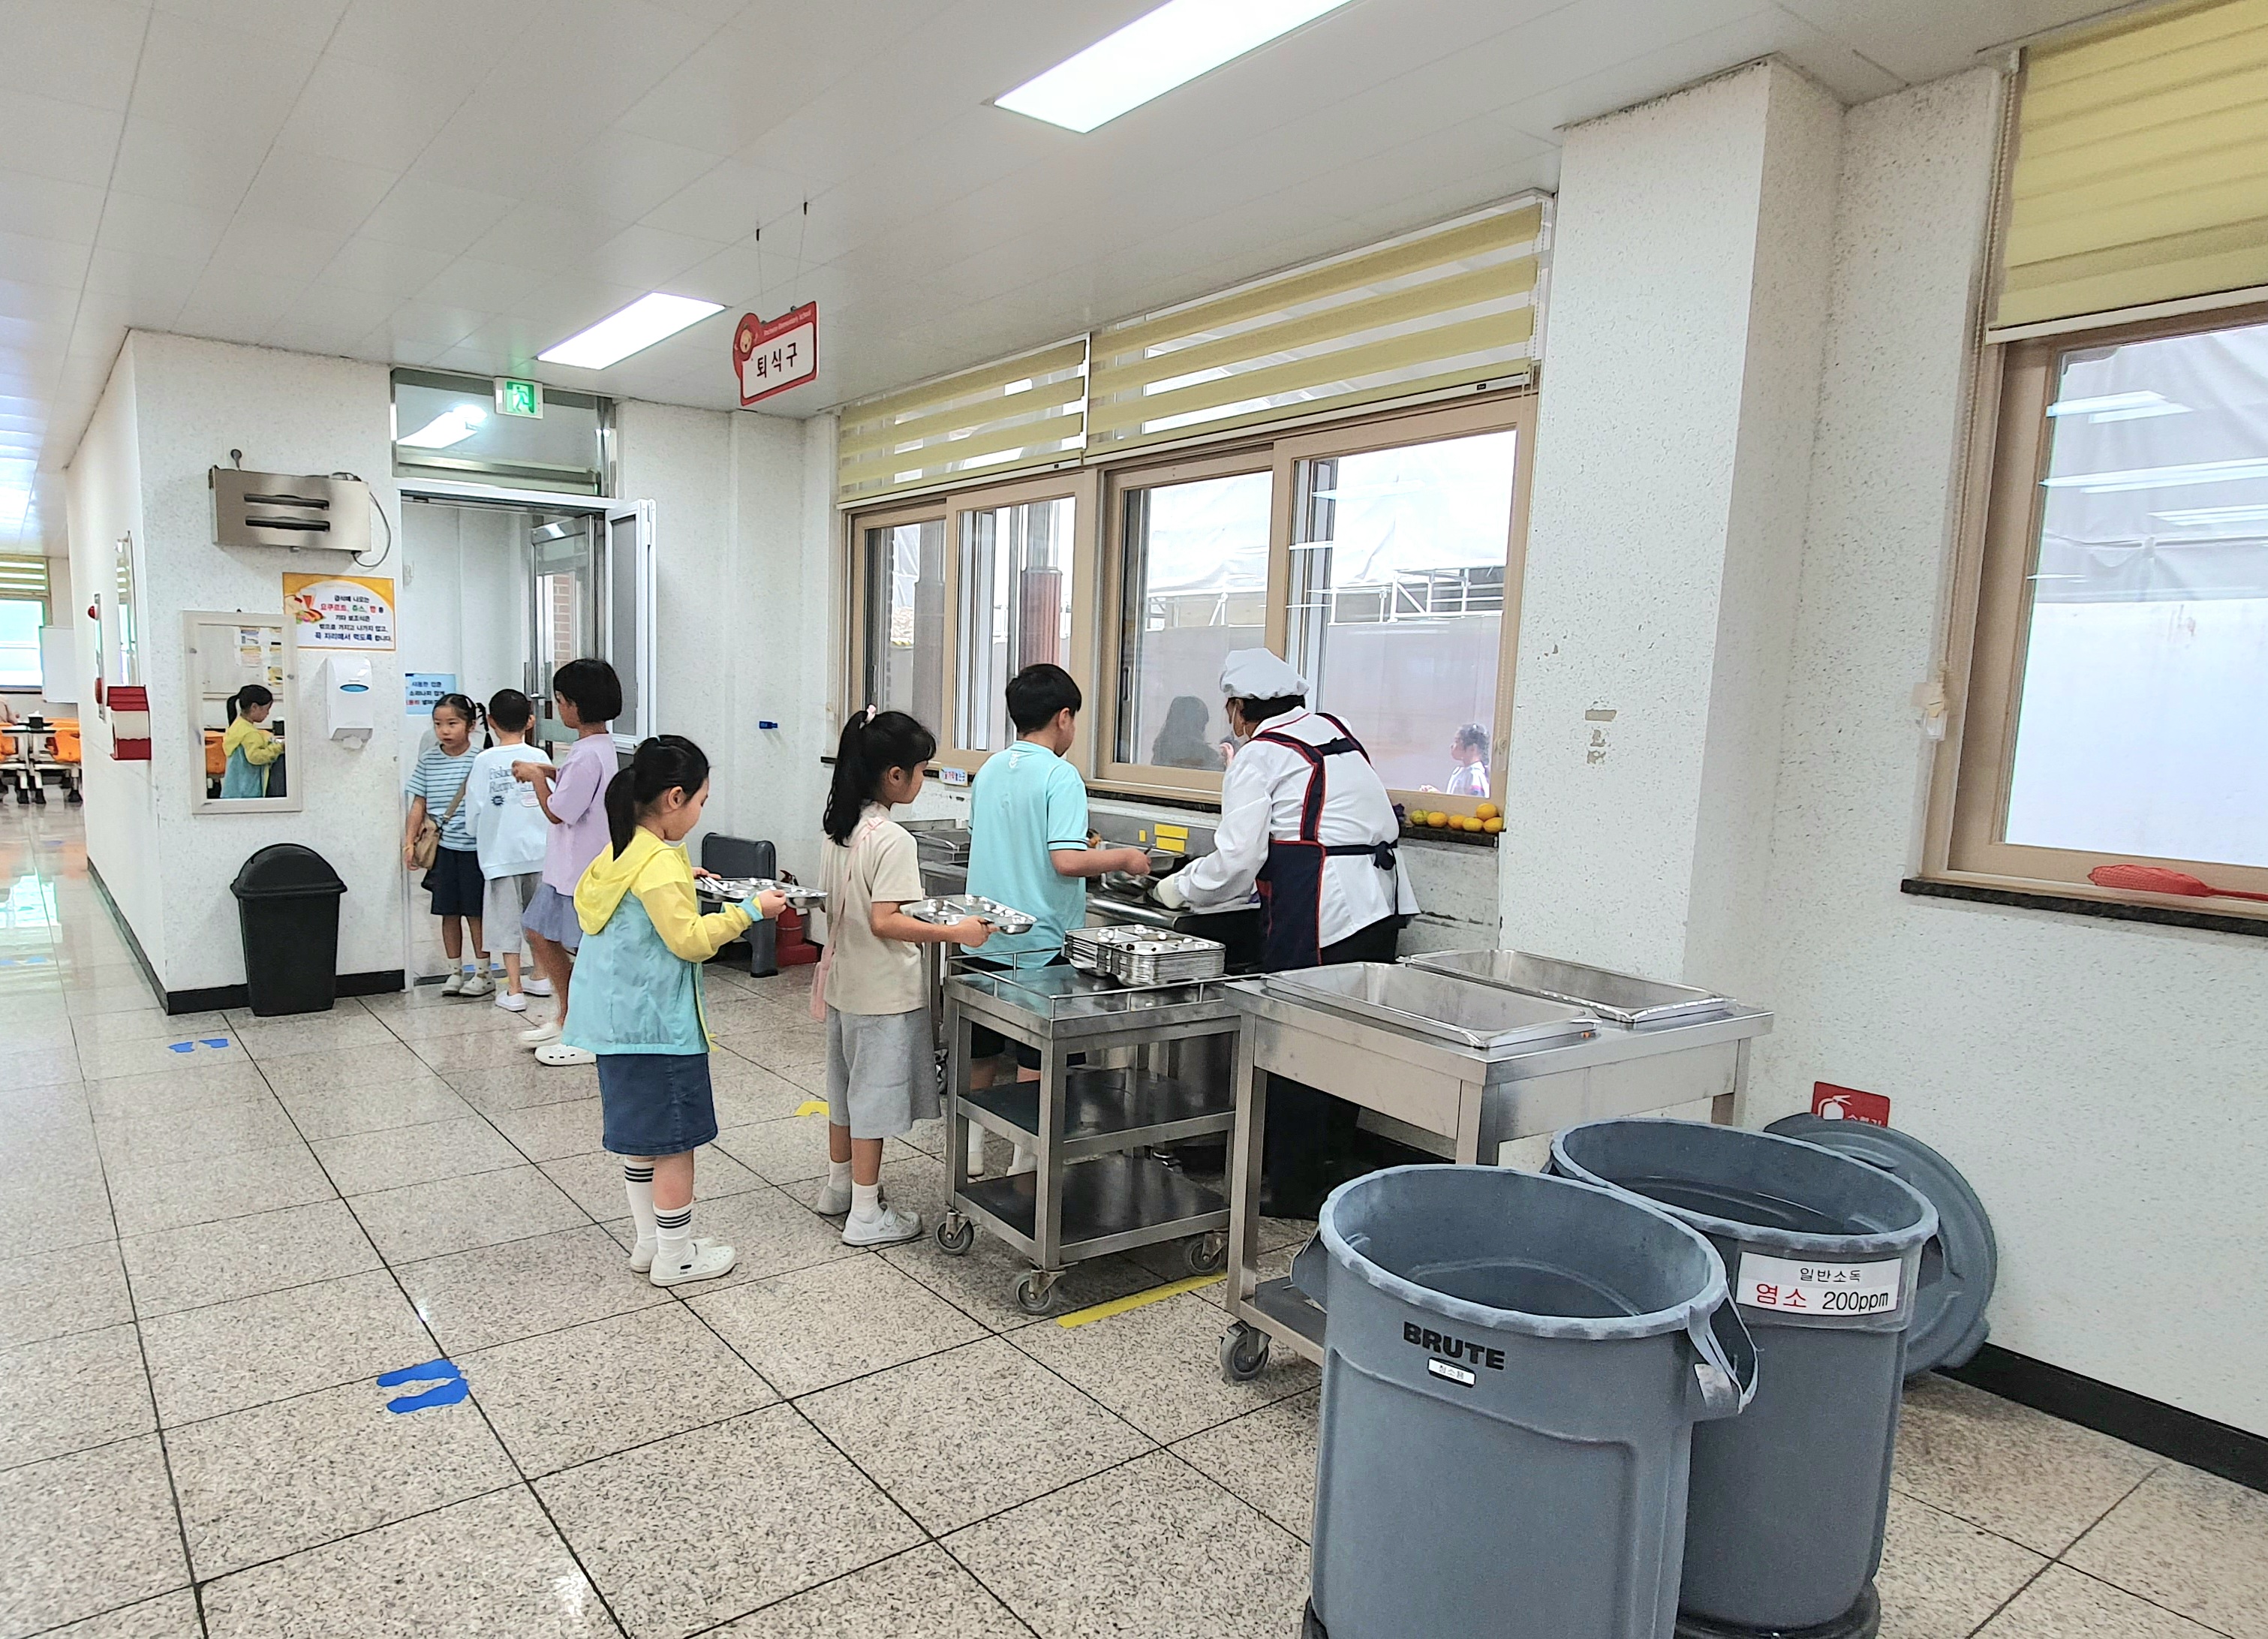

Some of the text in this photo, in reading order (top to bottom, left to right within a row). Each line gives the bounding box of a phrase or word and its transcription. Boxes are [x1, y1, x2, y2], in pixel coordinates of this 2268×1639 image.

[757, 341, 798, 378] 퇴식구
[1800, 1268, 1861, 1283] 일반소독
[1756, 1283, 1889, 1312] 염소 200ppm
[1403, 1321, 1505, 1370] BRUTE
